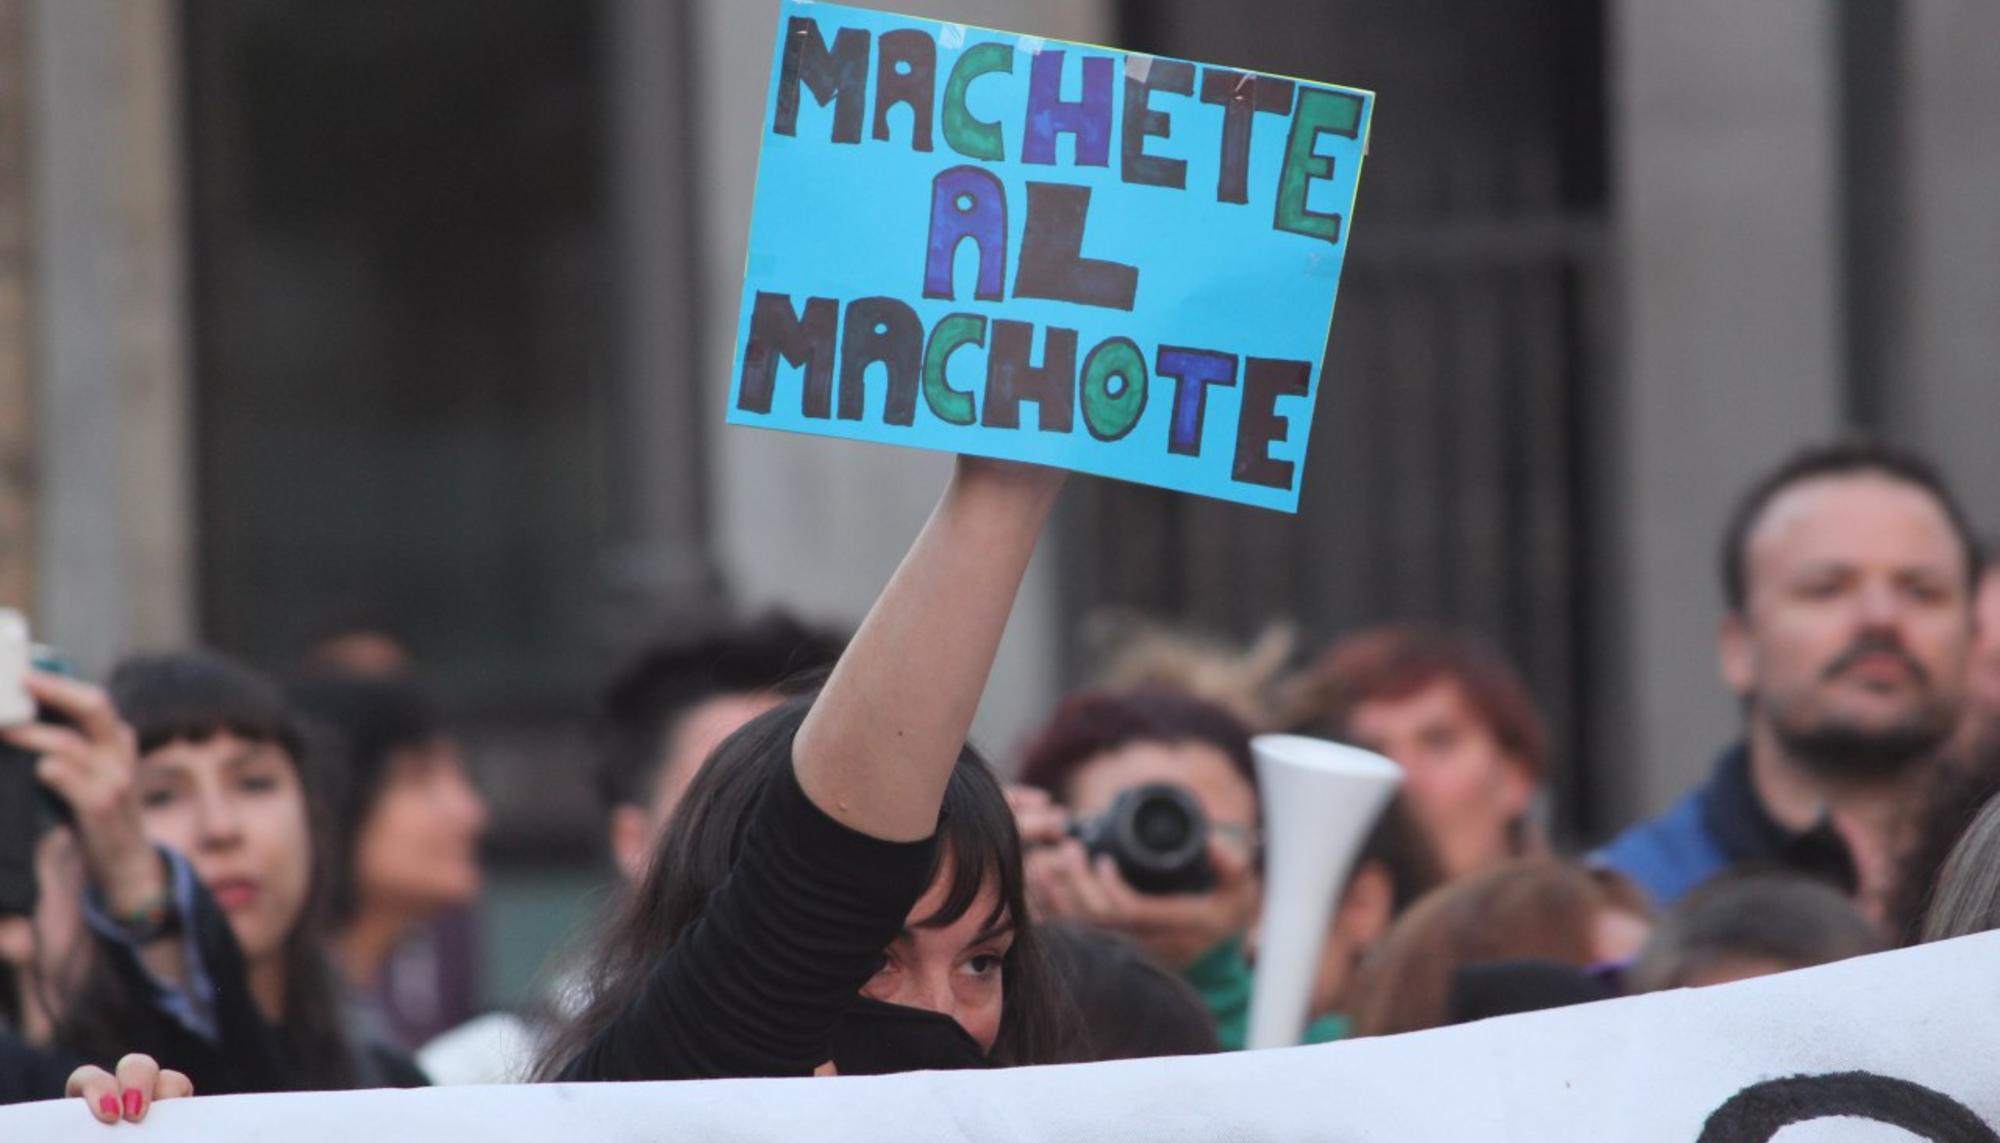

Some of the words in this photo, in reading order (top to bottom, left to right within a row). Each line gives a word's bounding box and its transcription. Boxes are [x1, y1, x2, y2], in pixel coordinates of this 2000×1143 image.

[773, 16, 1365, 243] MACHETE
[922, 164, 1139, 311] AL
[736, 290, 1311, 490] MACHOTE
